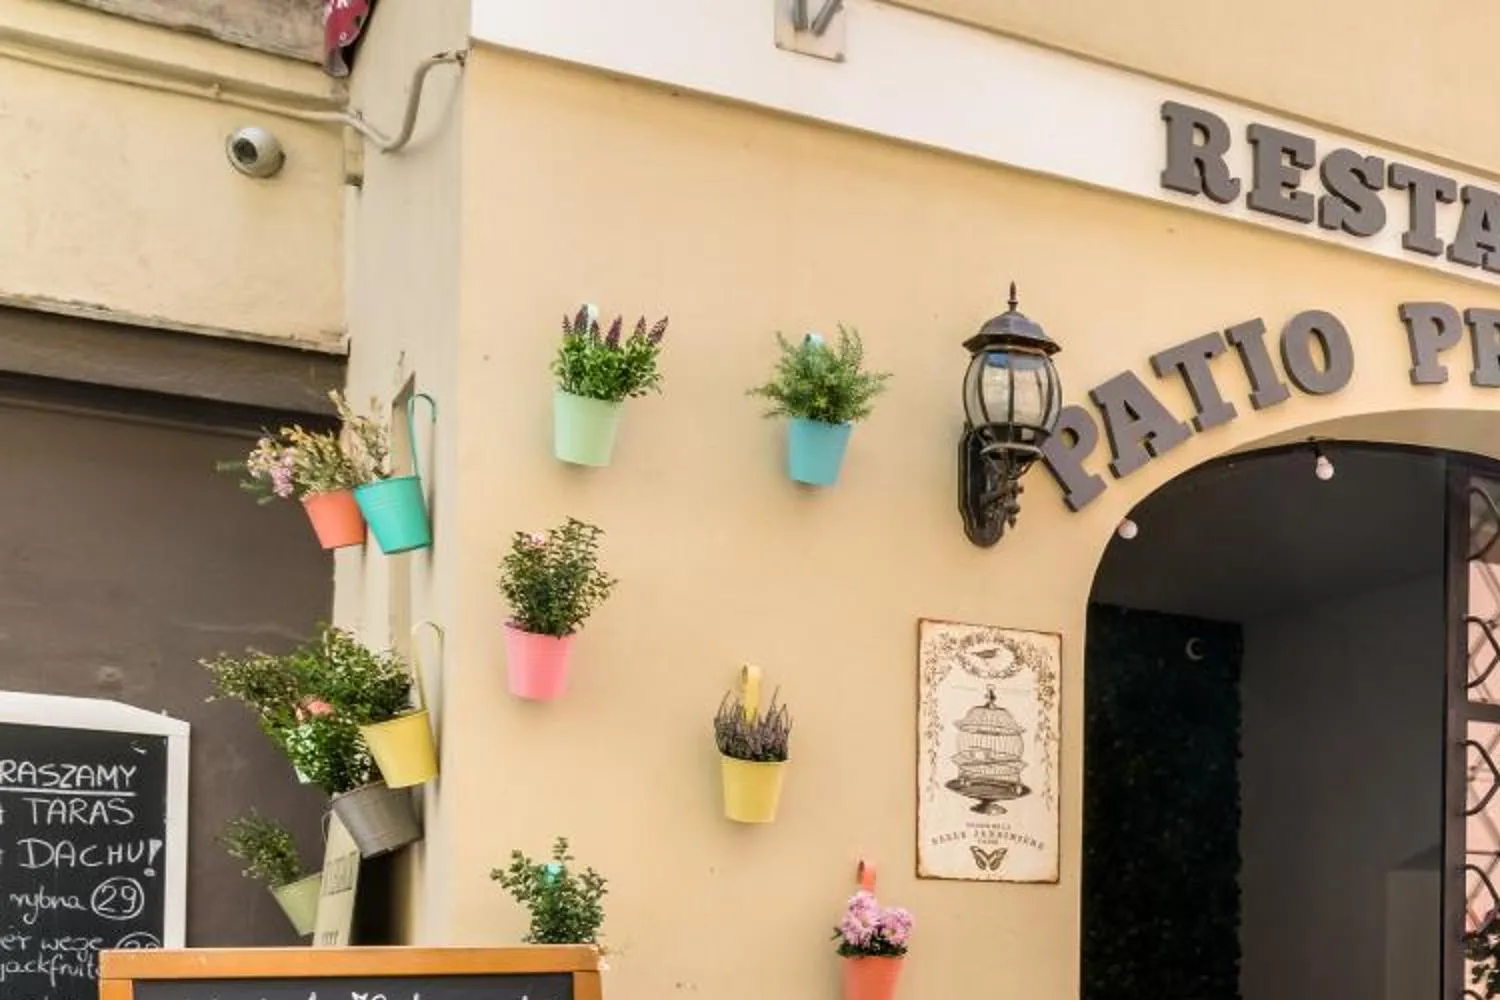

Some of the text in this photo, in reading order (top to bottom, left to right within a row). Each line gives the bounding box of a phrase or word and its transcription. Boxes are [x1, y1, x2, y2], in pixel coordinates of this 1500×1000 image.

[1040, 310, 1354, 512] PATIO
[0, 759, 137, 788] RASZAMY
[22, 797, 135, 825] TARAS
[16, 837, 163, 877] DACHU!
[98, 885, 137, 913] 29
[0, 951, 102, 988] jackfruit
